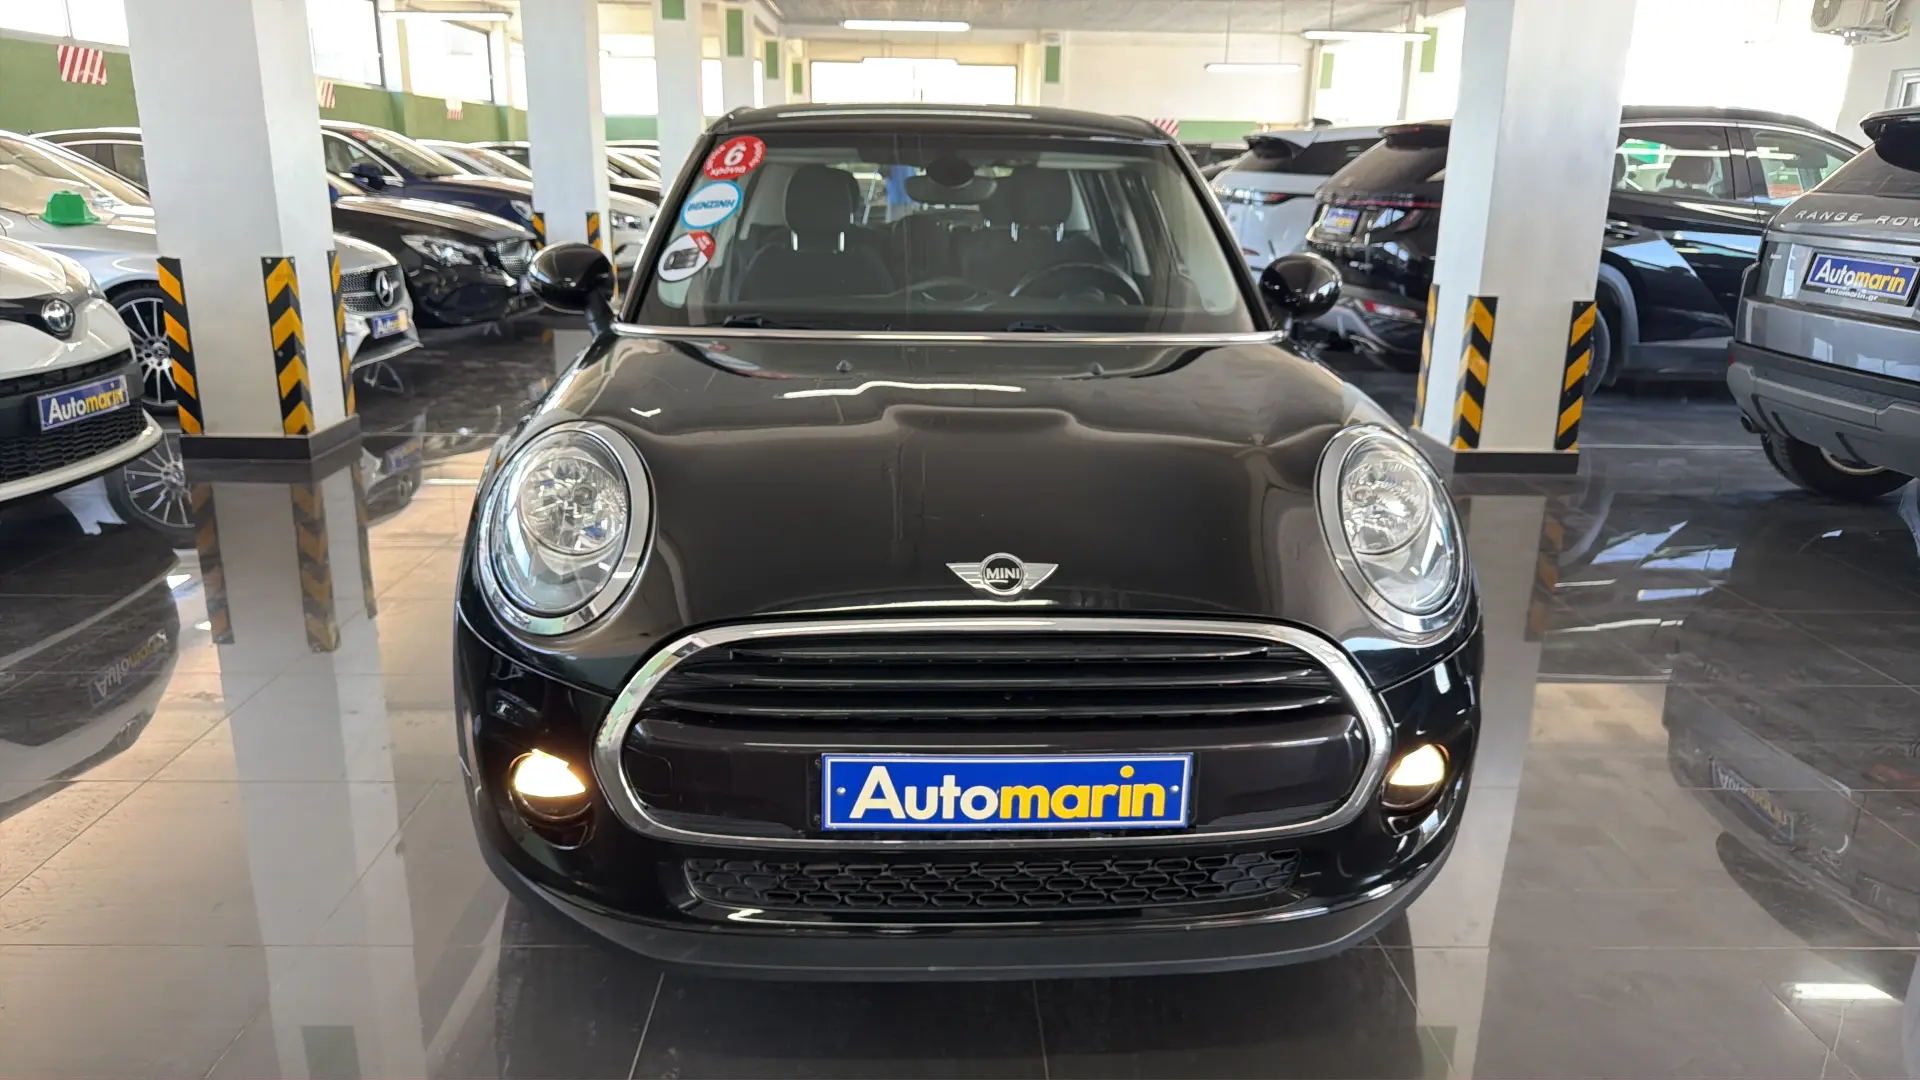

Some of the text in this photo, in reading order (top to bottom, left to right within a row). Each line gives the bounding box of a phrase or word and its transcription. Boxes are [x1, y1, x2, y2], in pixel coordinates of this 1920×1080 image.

[724, 143, 747, 167] 6
[1795, 210, 1863, 222] RANGE
[1814, 258, 1906, 294] Automarin
[48, 381, 124, 425] Automarin
[986, 567, 1020, 580] MINI
[849, 764, 1166, 820] Automarin
